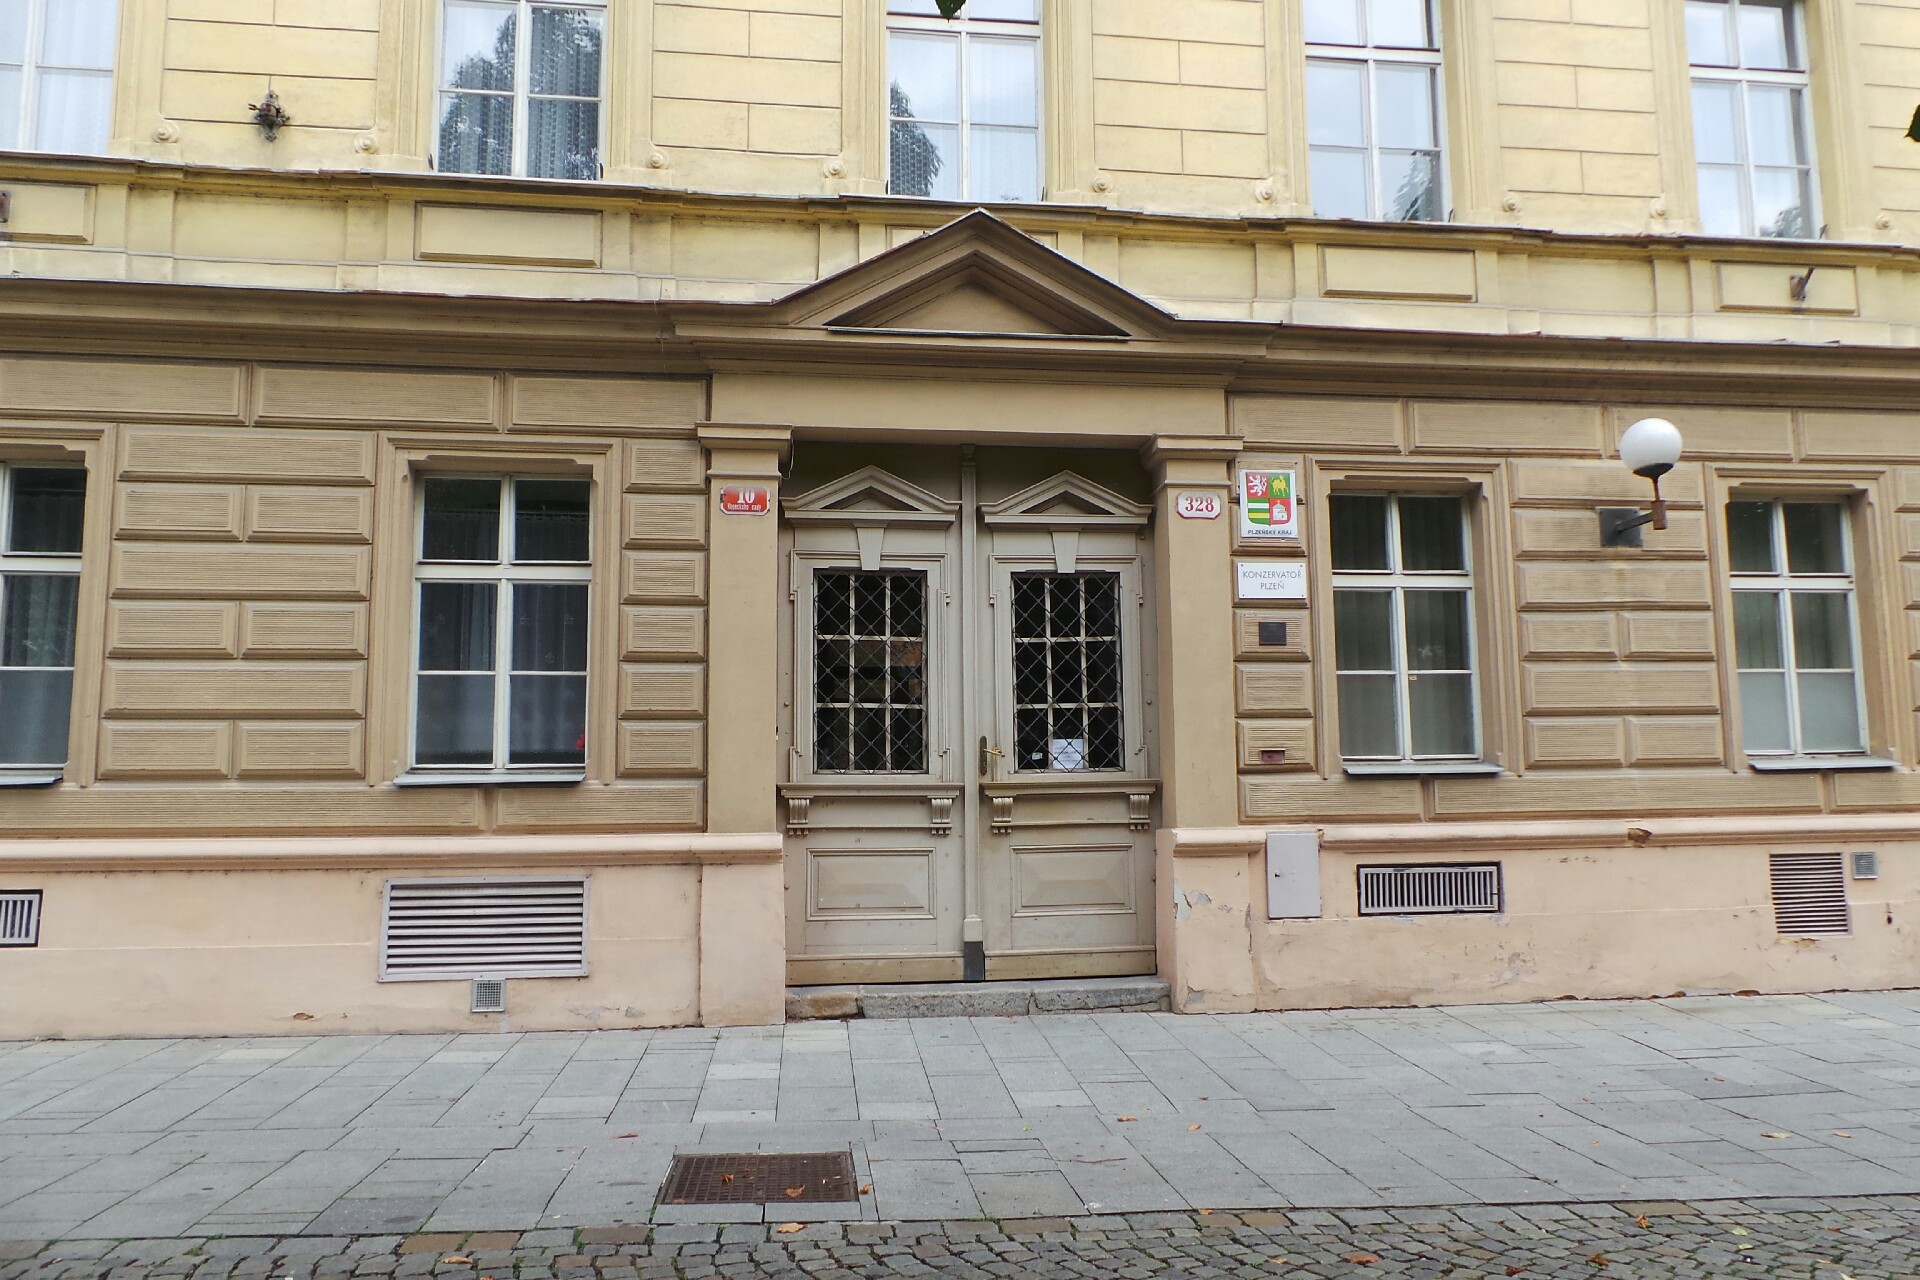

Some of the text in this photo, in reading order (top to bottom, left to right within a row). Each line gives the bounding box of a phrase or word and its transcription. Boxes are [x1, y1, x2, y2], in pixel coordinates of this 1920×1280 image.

[737, 488, 755, 504] 10
[1185, 496, 1214, 512] 328
[1247, 527, 1276, 535] PLZEŇSKÝ
[1242, 569, 1302, 579] KONZERVATOŘ
[1260, 580, 1285, 590] PLZEŇ
